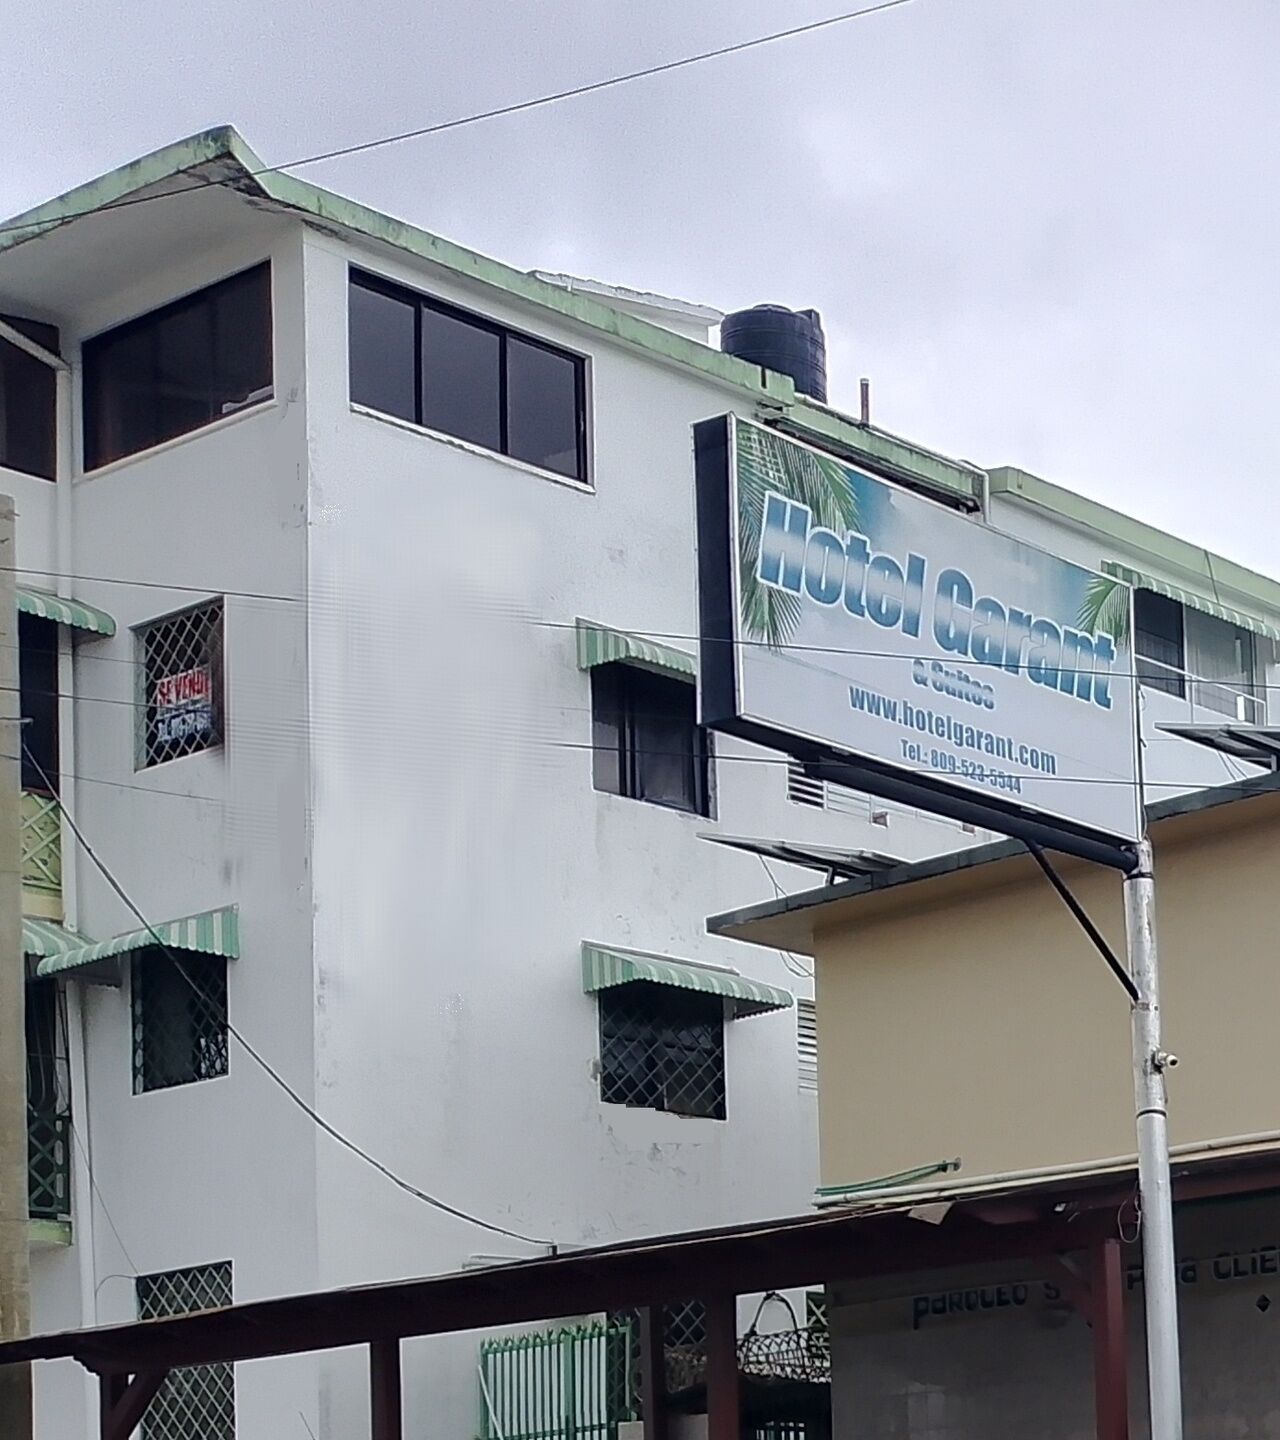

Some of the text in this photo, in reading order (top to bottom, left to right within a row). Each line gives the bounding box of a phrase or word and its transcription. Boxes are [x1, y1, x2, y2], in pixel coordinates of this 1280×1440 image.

[756, 491, 1116, 710] Hotel Garant
[911, 658, 995, 710] & Suites
[849, 685, 1056, 776] www.hotelgarant.com
[930, 749, 1022, 794] 809-523-5544
